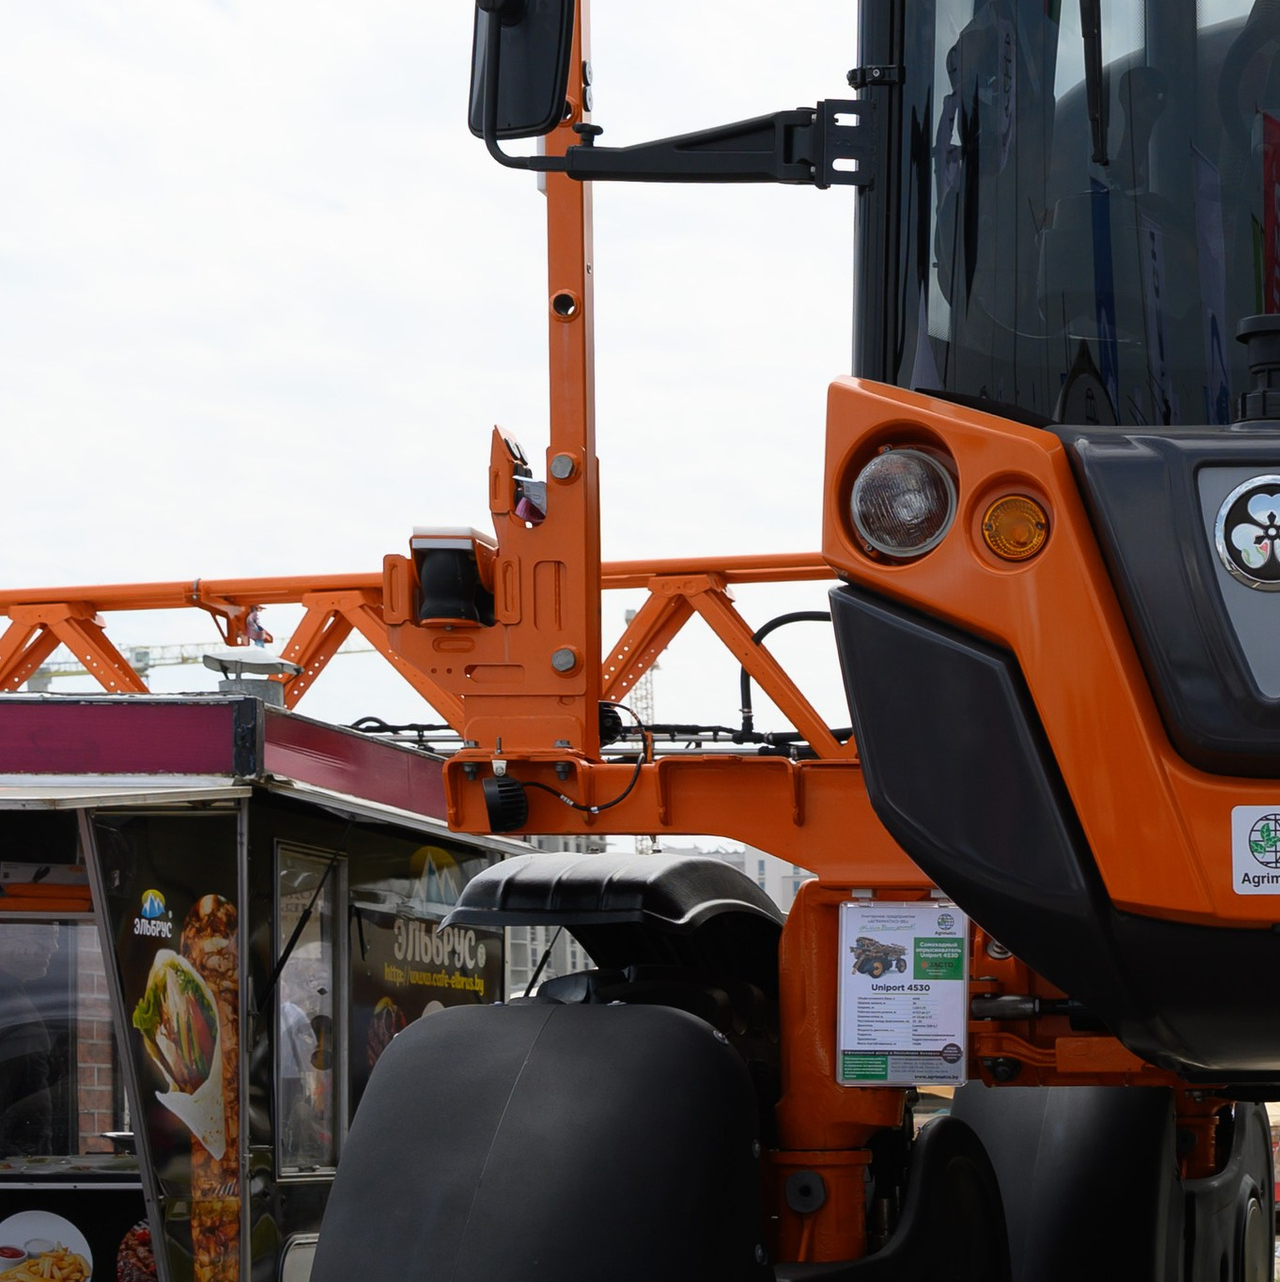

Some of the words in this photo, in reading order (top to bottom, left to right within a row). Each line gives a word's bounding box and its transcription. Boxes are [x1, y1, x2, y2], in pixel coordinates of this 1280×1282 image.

[134, 918, 172, 938] ЭЛЬБРУС
[871, 983, 905, 992] Uniport
[907, 984, 931, 992] 4530
